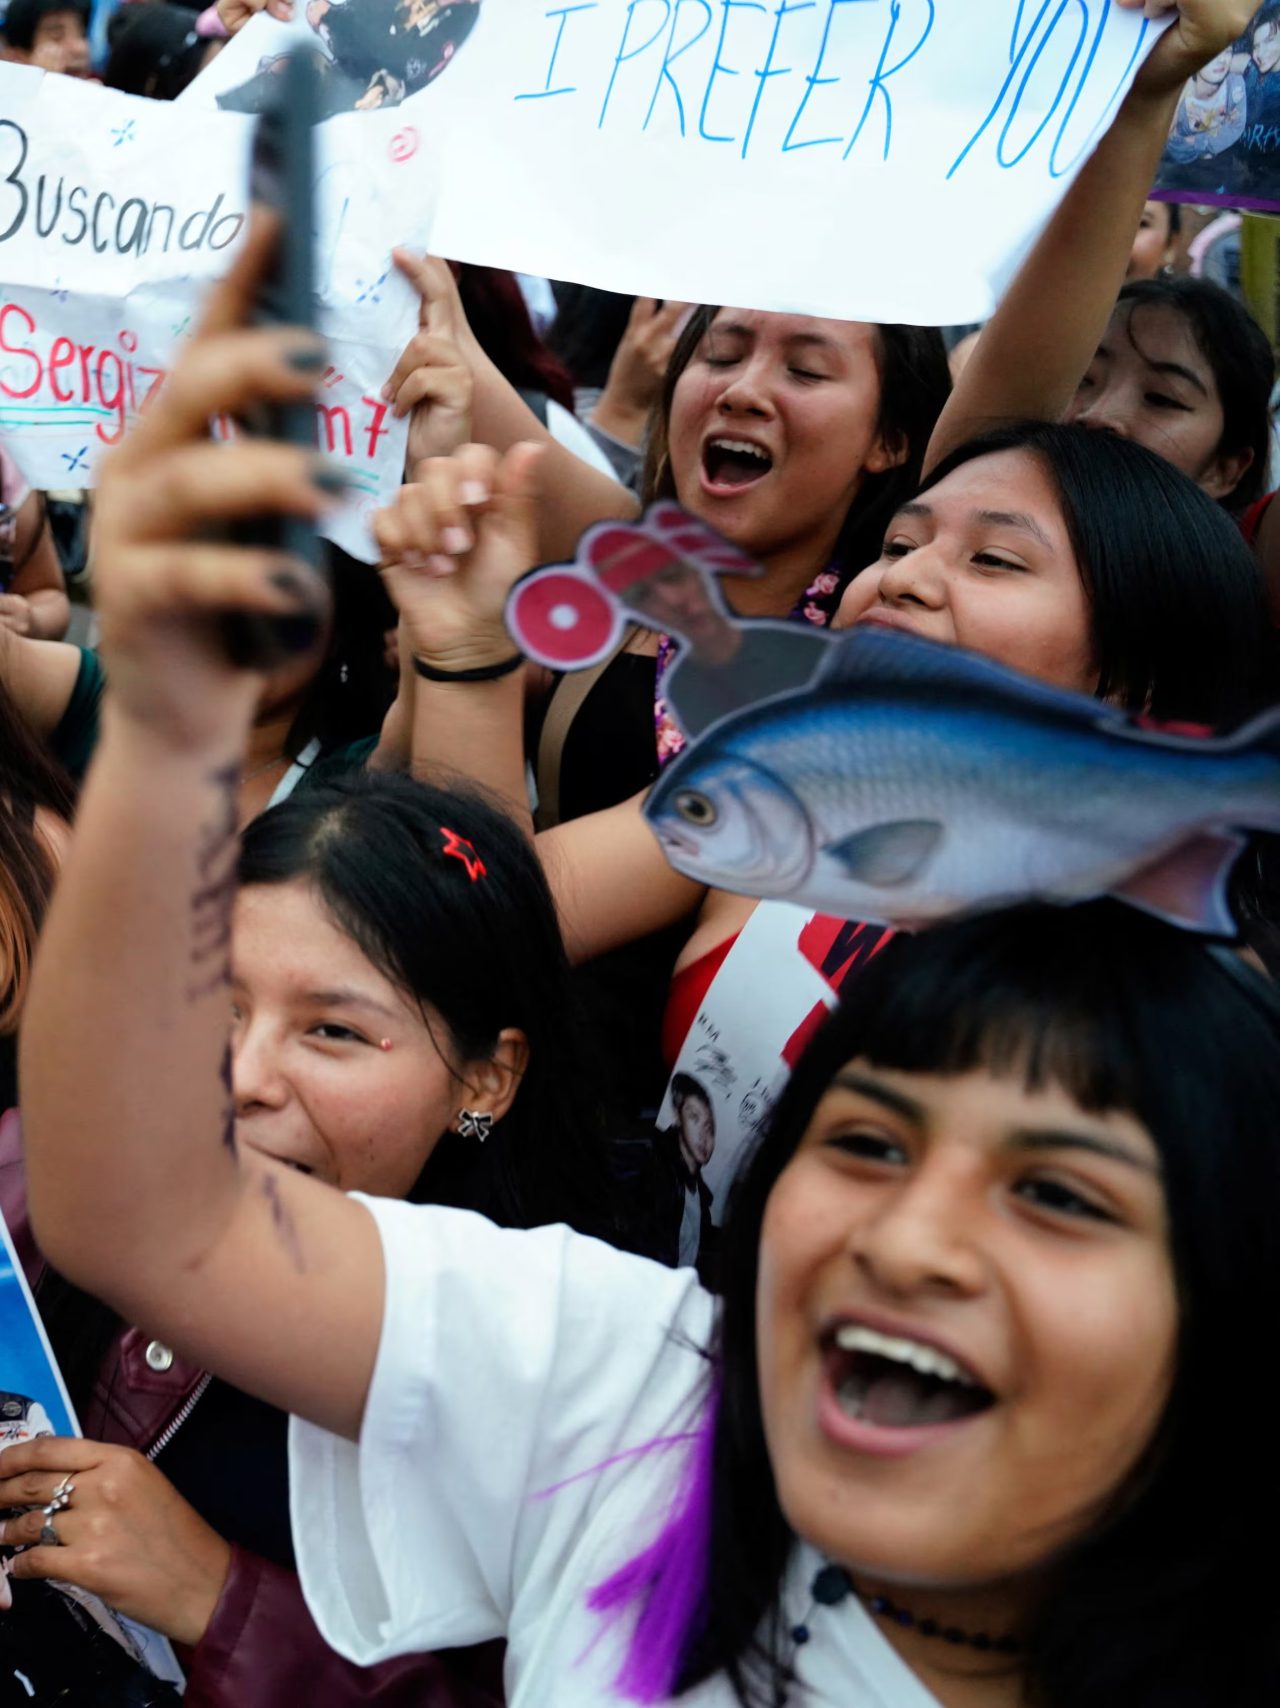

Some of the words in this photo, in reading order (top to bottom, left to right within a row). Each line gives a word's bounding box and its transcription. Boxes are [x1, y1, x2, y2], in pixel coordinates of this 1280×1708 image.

[514, 3, 599, 101] I
[598, 0, 934, 162] PREFER
[945, 0, 1149, 180] YOU
